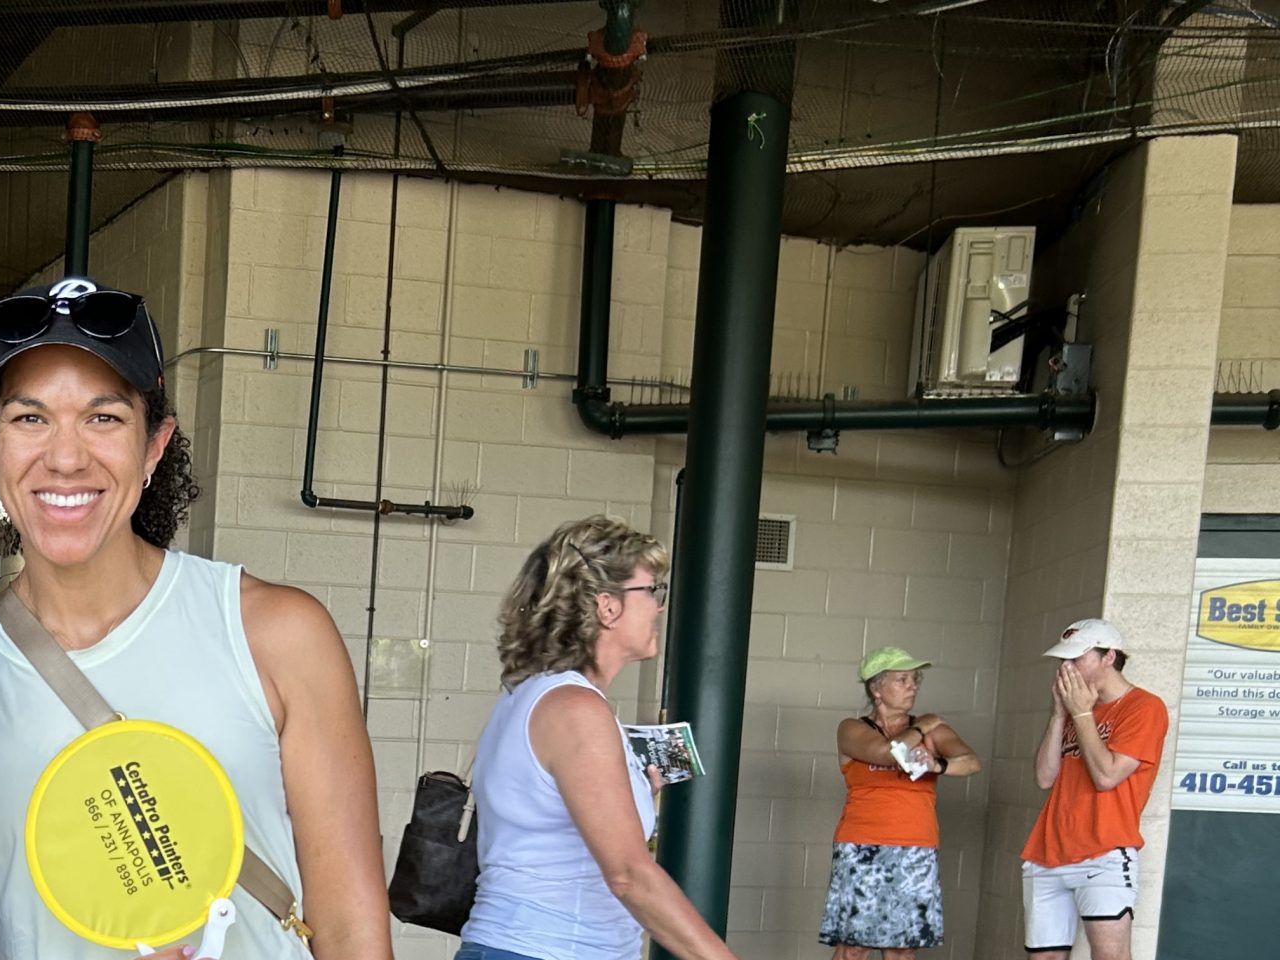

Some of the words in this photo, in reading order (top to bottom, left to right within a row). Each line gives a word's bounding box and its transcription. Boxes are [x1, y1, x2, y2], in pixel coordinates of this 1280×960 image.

[1208, 597, 1267, 622] Best
[1196, 688, 1239, 697] behind
[1242, 689, 1264, 698] this
[1218, 706, 1265, 718] Storage
[1223, 761, 1247, 769] Call
[125, 761, 160, 823] CertaPro
[84, 797, 103, 822] 866
[101, 832, 118, 854] 231
[116, 864, 138, 895] 8998
[100, 789, 117, 808] OF
[110, 812, 153, 887] ANNAPOLIS
